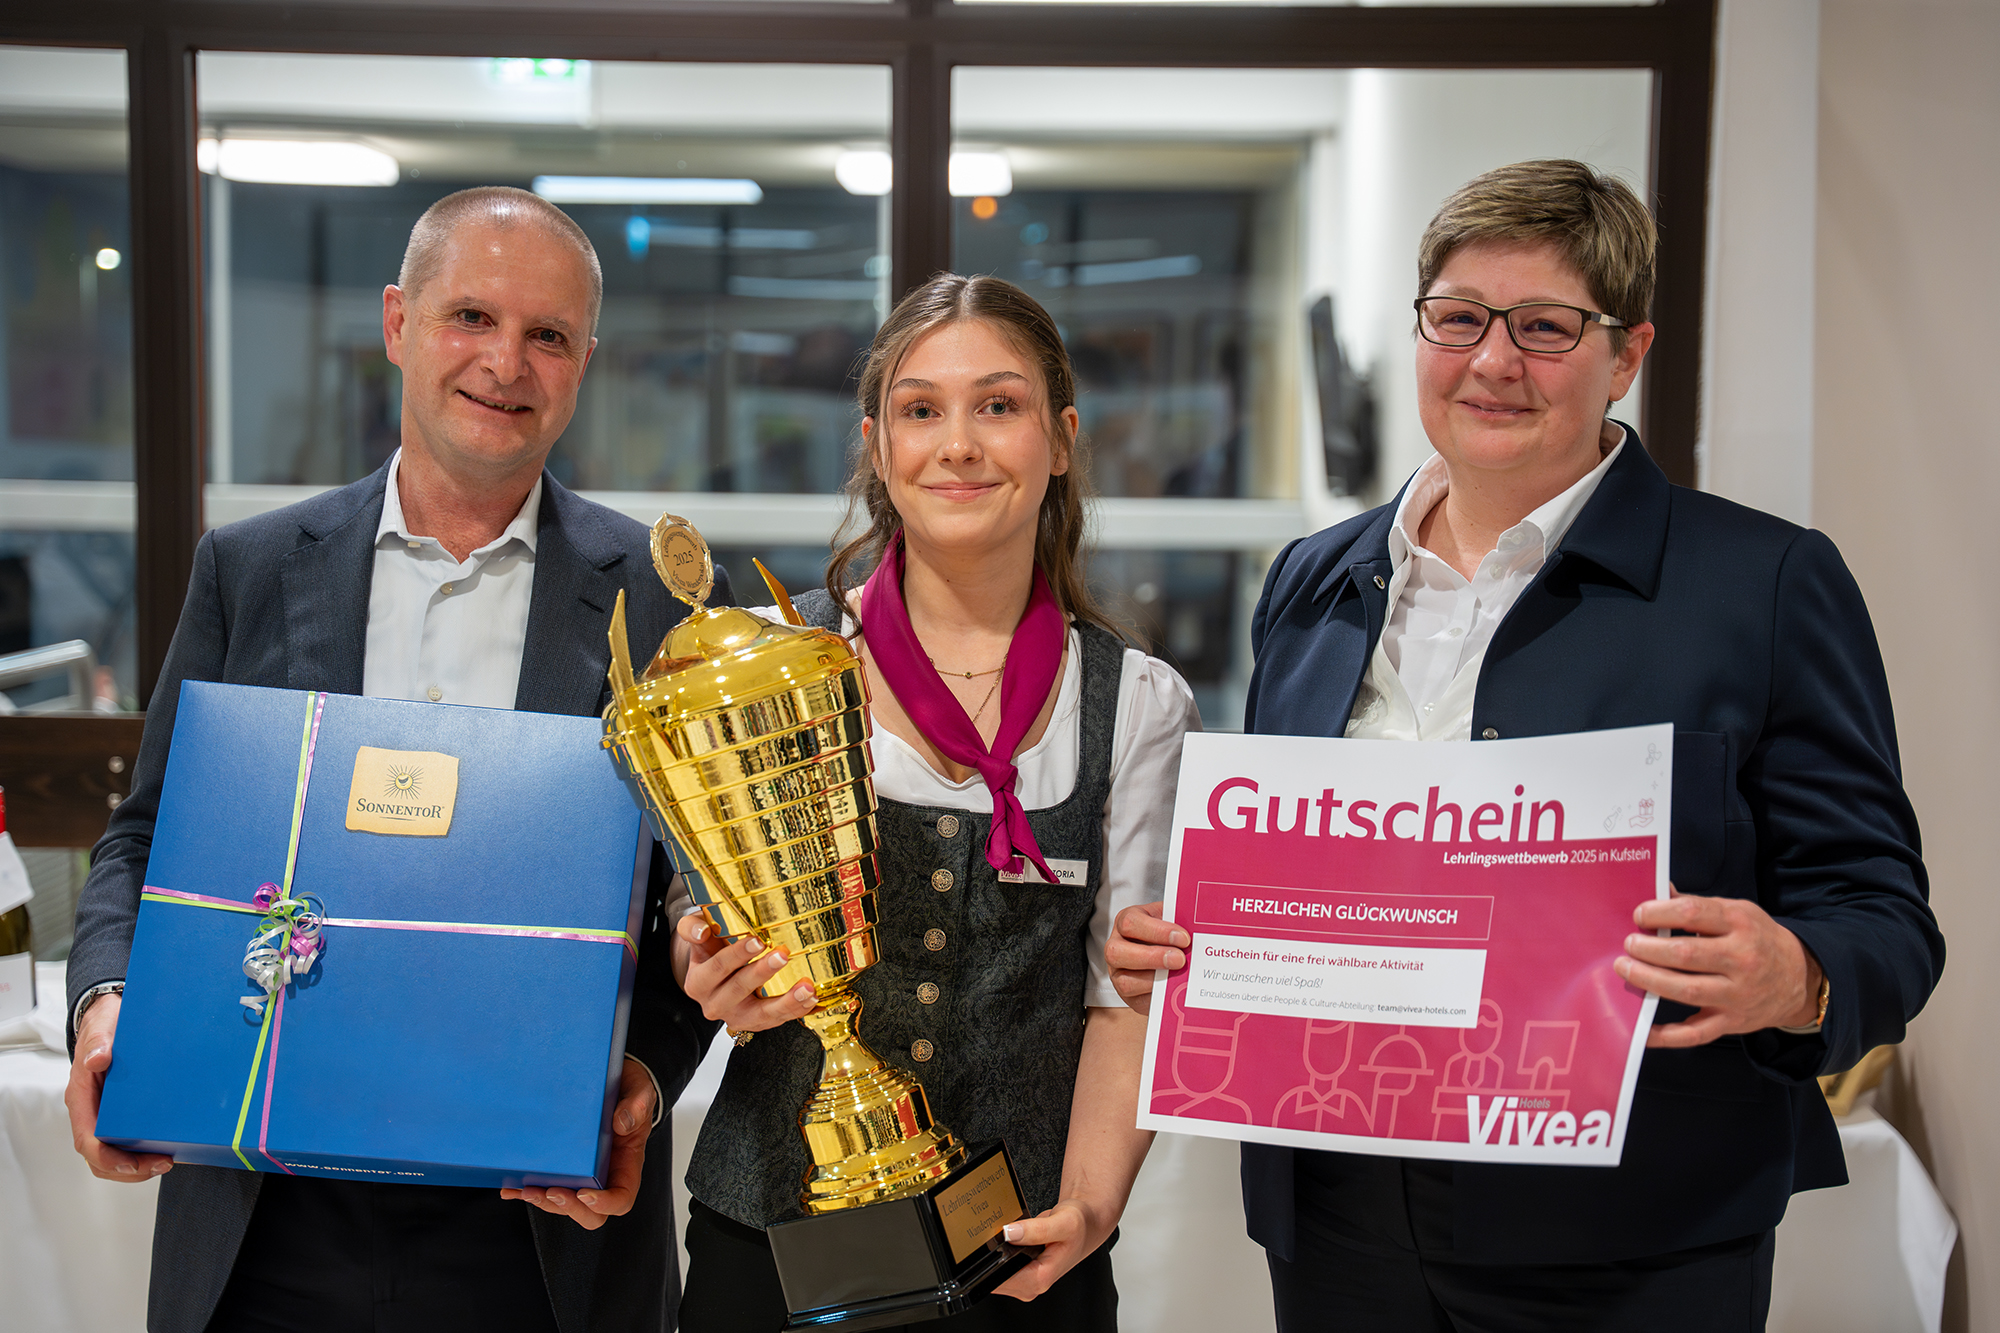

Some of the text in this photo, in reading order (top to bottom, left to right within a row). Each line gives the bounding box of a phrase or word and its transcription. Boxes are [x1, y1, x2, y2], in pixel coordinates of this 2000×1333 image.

[673, 551, 694, 566] 2025
[1207, 776, 1565, 842] Gutschein
[1443, 846, 1651, 867] Lehrlingswettbewerb 2025 in Kufstein
[1232, 897, 1458, 925] HERZLICHEN GLÜCKWUNSCH
[1204, 946, 1425, 972] Gutschein für eine frei wählbare Aktivität
[1203, 968, 1324, 990] Wir wünschen viel Spaß!
[1199, 988, 1240, 1000] Einzulösen
[1241, 991, 1260, 1002] über
[1260, 993, 1273, 1004] die
[1274, 995, 1301, 1007] People
[1301, 998, 1308, 1007] &
[1377, 1003, 1467, 1016] team@vivea-hotels.com
[1518, 1096, 1551, 1110] Hotels
[1467, 1095, 1611, 1148] Vivea
[942, 1164, 1006, 1217] Lehrlingswettbewerb
[970, 1199, 990, 1216] Vivea
[966, 1206, 1005, 1239] Wanderpokal
